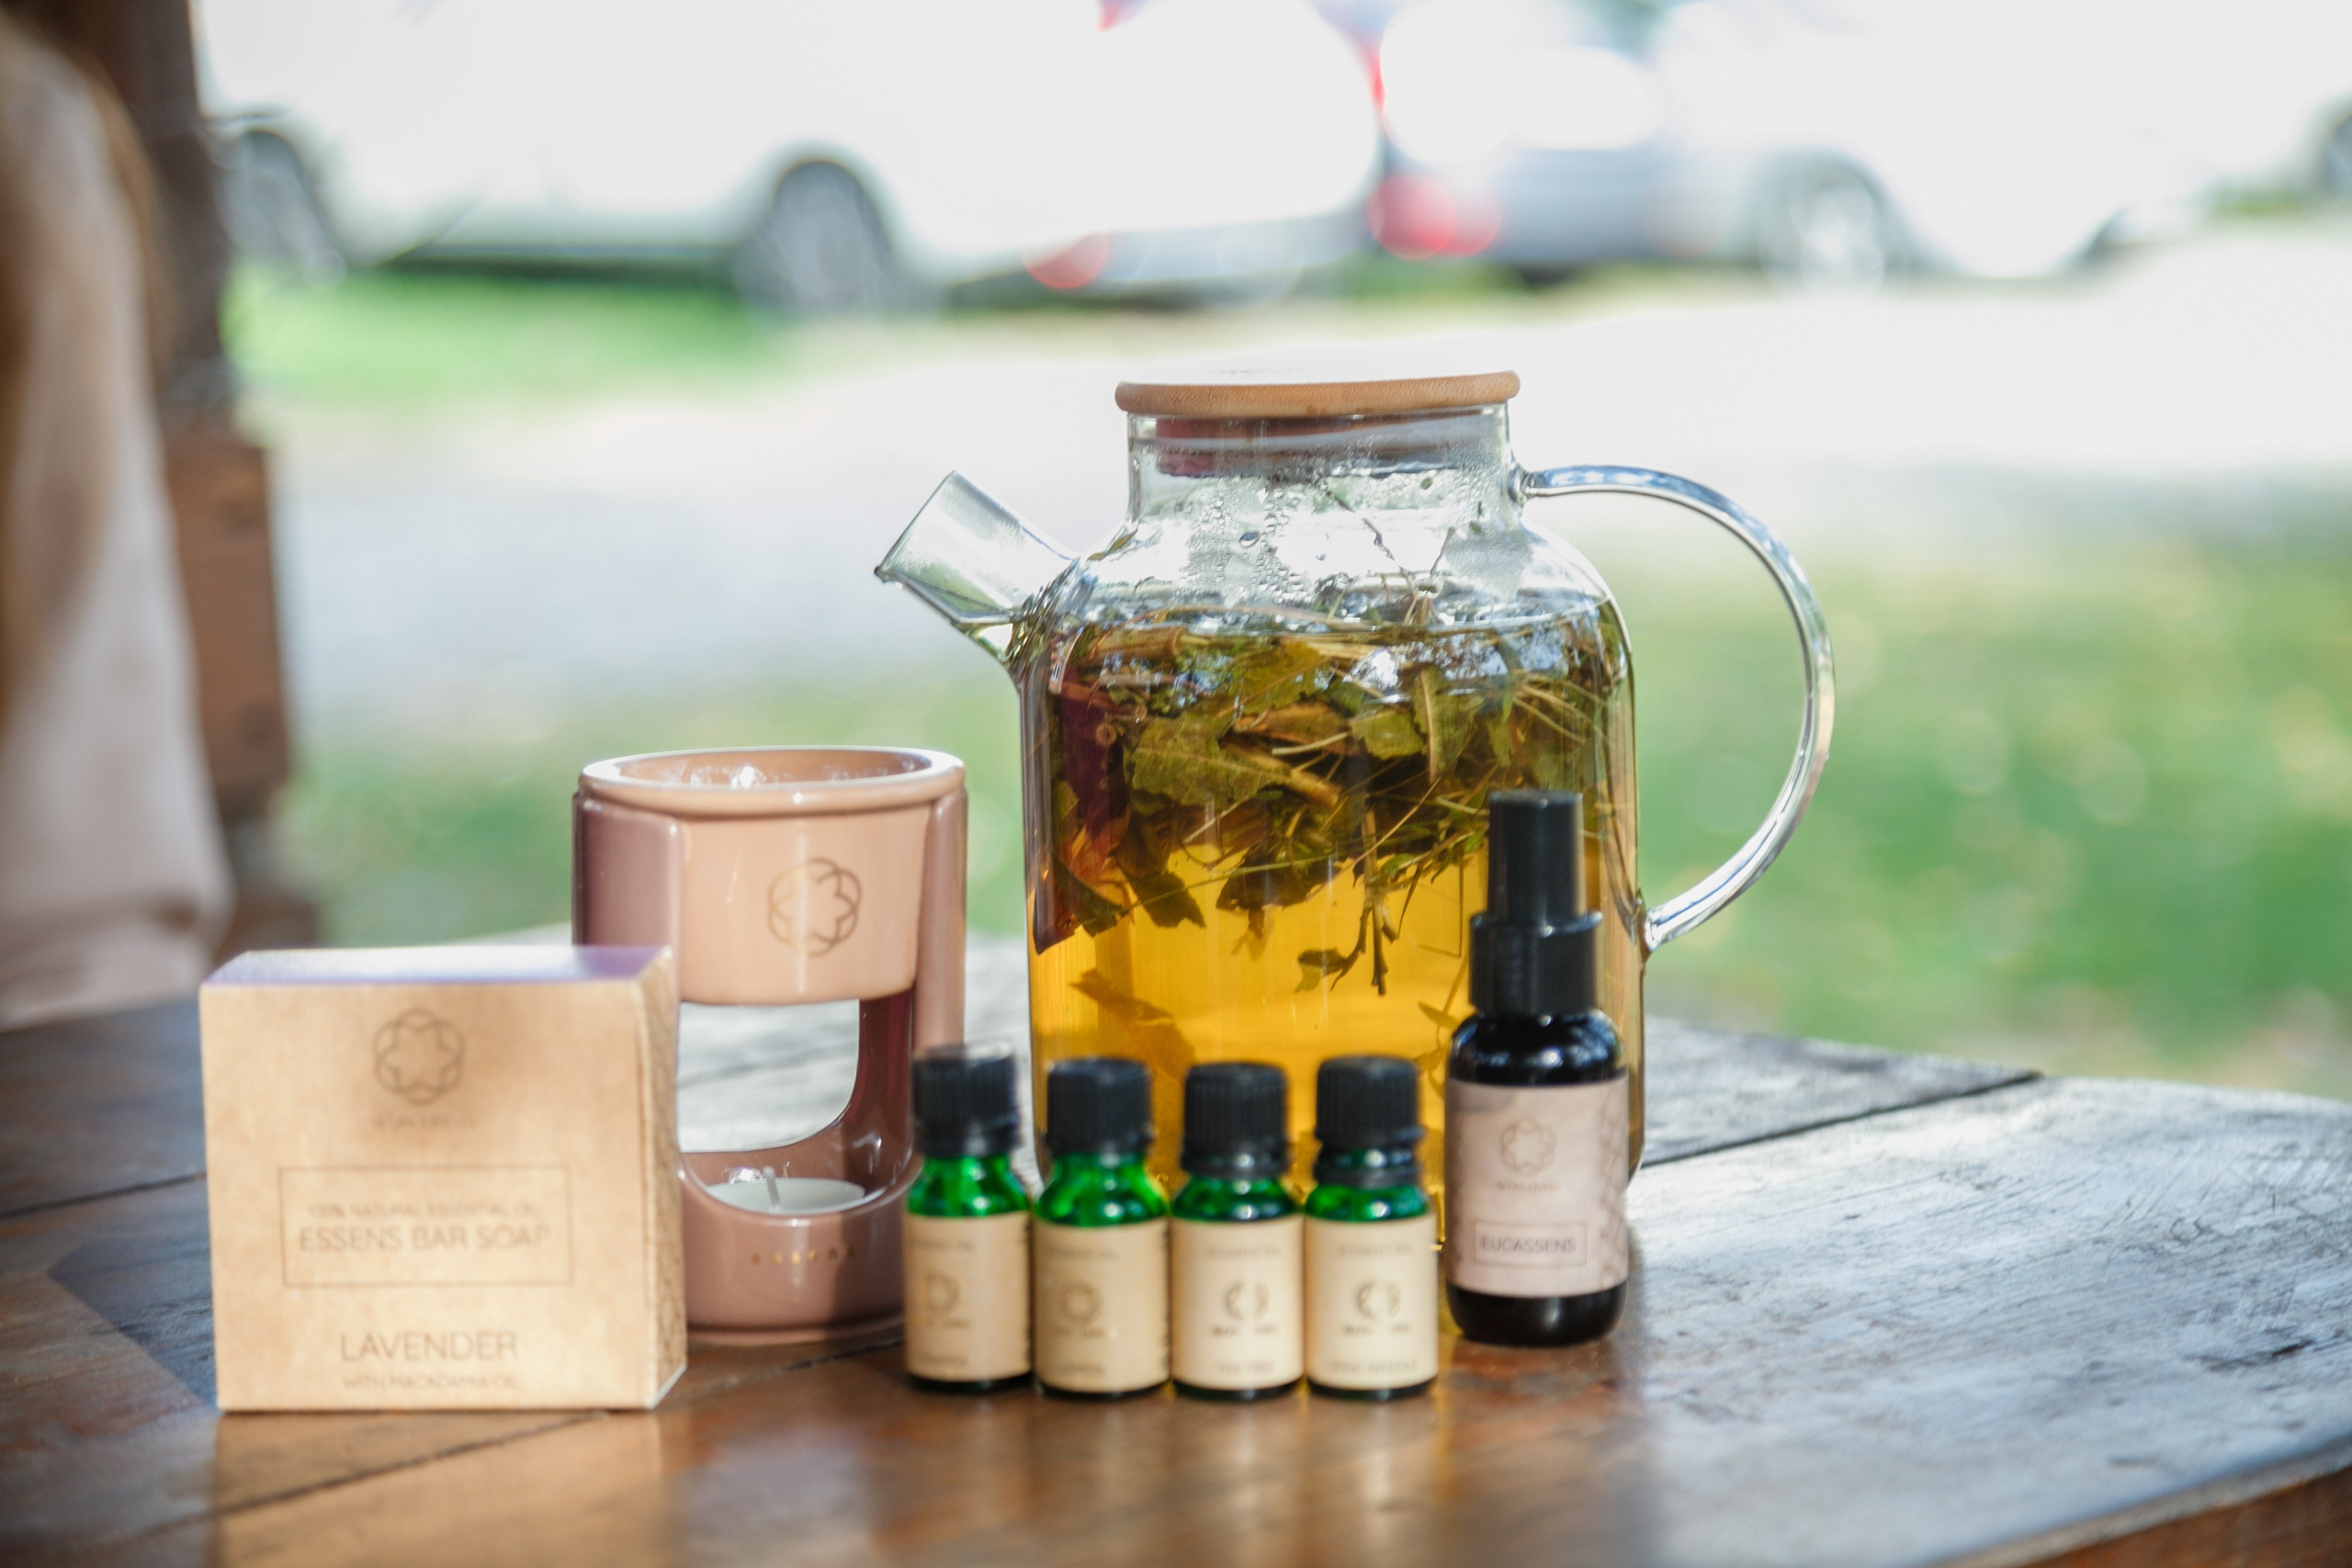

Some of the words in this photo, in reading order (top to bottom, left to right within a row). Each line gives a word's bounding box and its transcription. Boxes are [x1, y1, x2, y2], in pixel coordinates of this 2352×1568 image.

[300, 1224, 402, 1252] ESSENS
[412, 1224, 469, 1251] BAR
[476, 1222, 551, 1250] SOAP
[1480, 1235, 1577, 1255] EUCASSENS
[340, 1330, 519, 1362] LAVENDER
[342, 1373, 386, 1390] WITH
[390, 1373, 489, 1389] MACADAMIA
